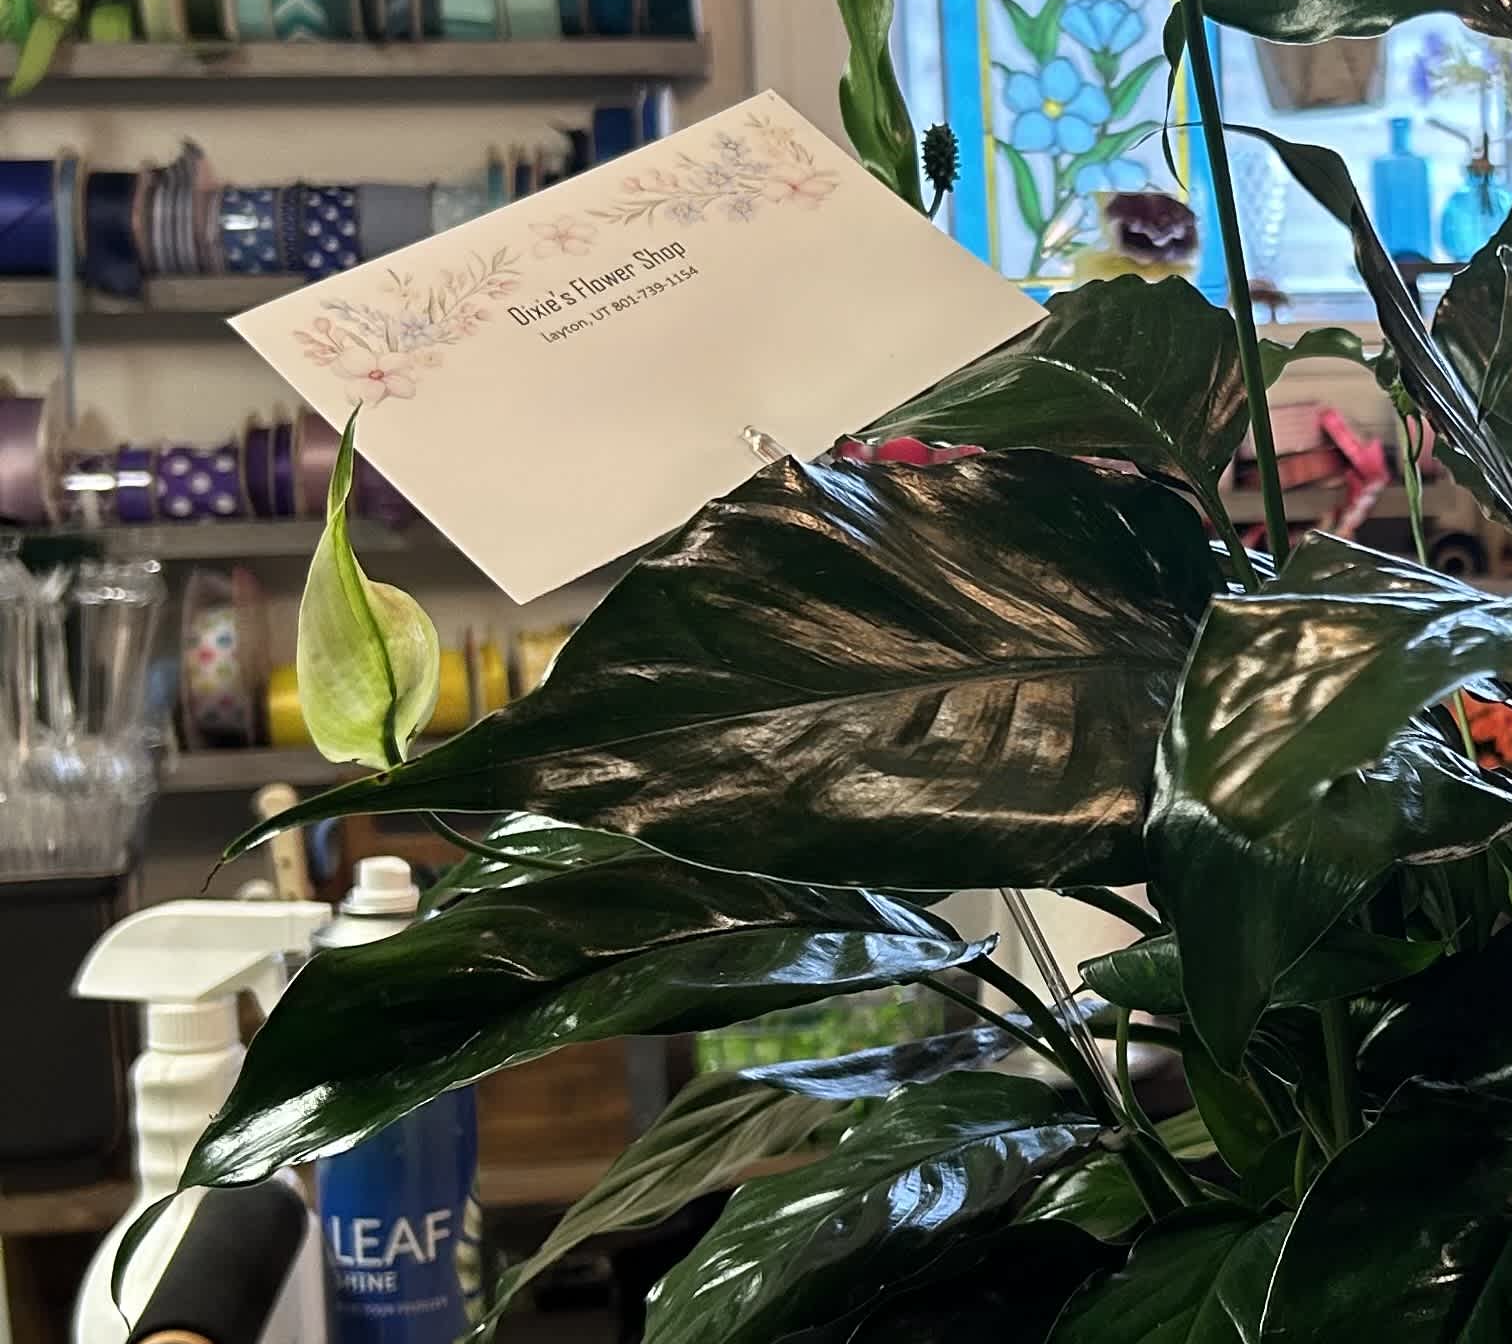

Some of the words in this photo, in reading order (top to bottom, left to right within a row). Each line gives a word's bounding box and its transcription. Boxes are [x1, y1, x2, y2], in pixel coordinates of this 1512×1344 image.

[507, 290, 578, 326] Dixie's
[569, 264, 636, 299] Flower
[632, 242, 686, 270] Shop
[540, 320, 594, 344] Layton,
[590, 306, 611, 321] UT
[611, 266, 699, 312] 801-739-1154
[331, 1209, 452, 1267] LEAF
[336, 1271, 399, 1294] HINE
